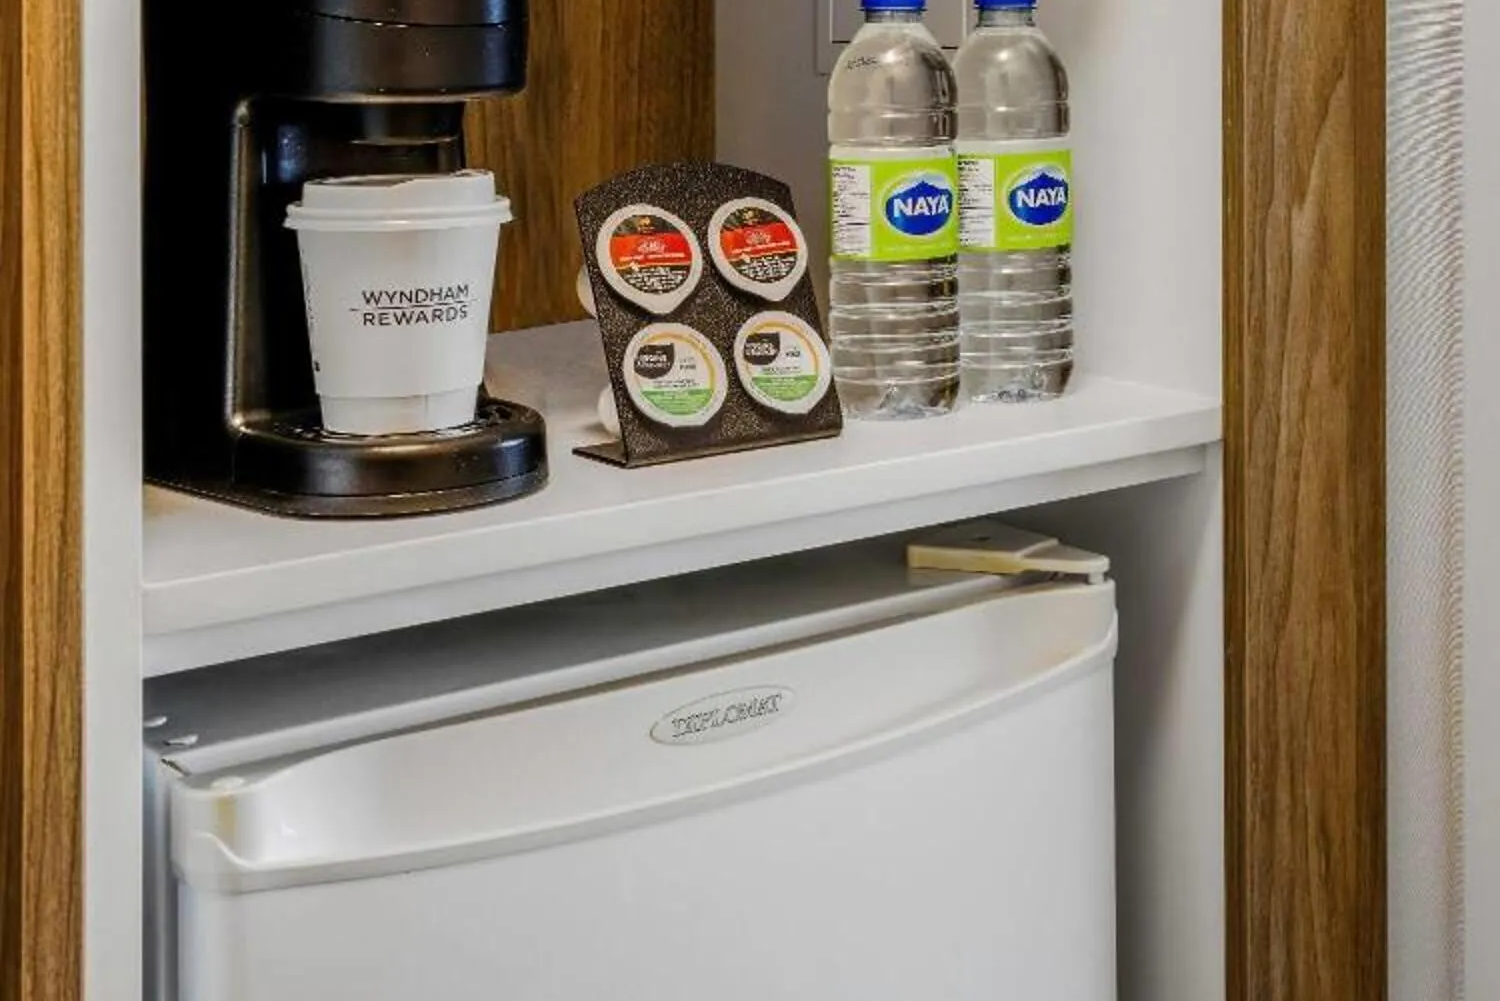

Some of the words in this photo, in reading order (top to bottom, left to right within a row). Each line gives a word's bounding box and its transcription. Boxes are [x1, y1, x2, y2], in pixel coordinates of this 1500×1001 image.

[893, 194, 950, 218] NAYA
[1016, 187, 1066, 208] NAYA
[361, 283, 469, 306] WYNDHAM
[362, 304, 469, 326] REWARDS
